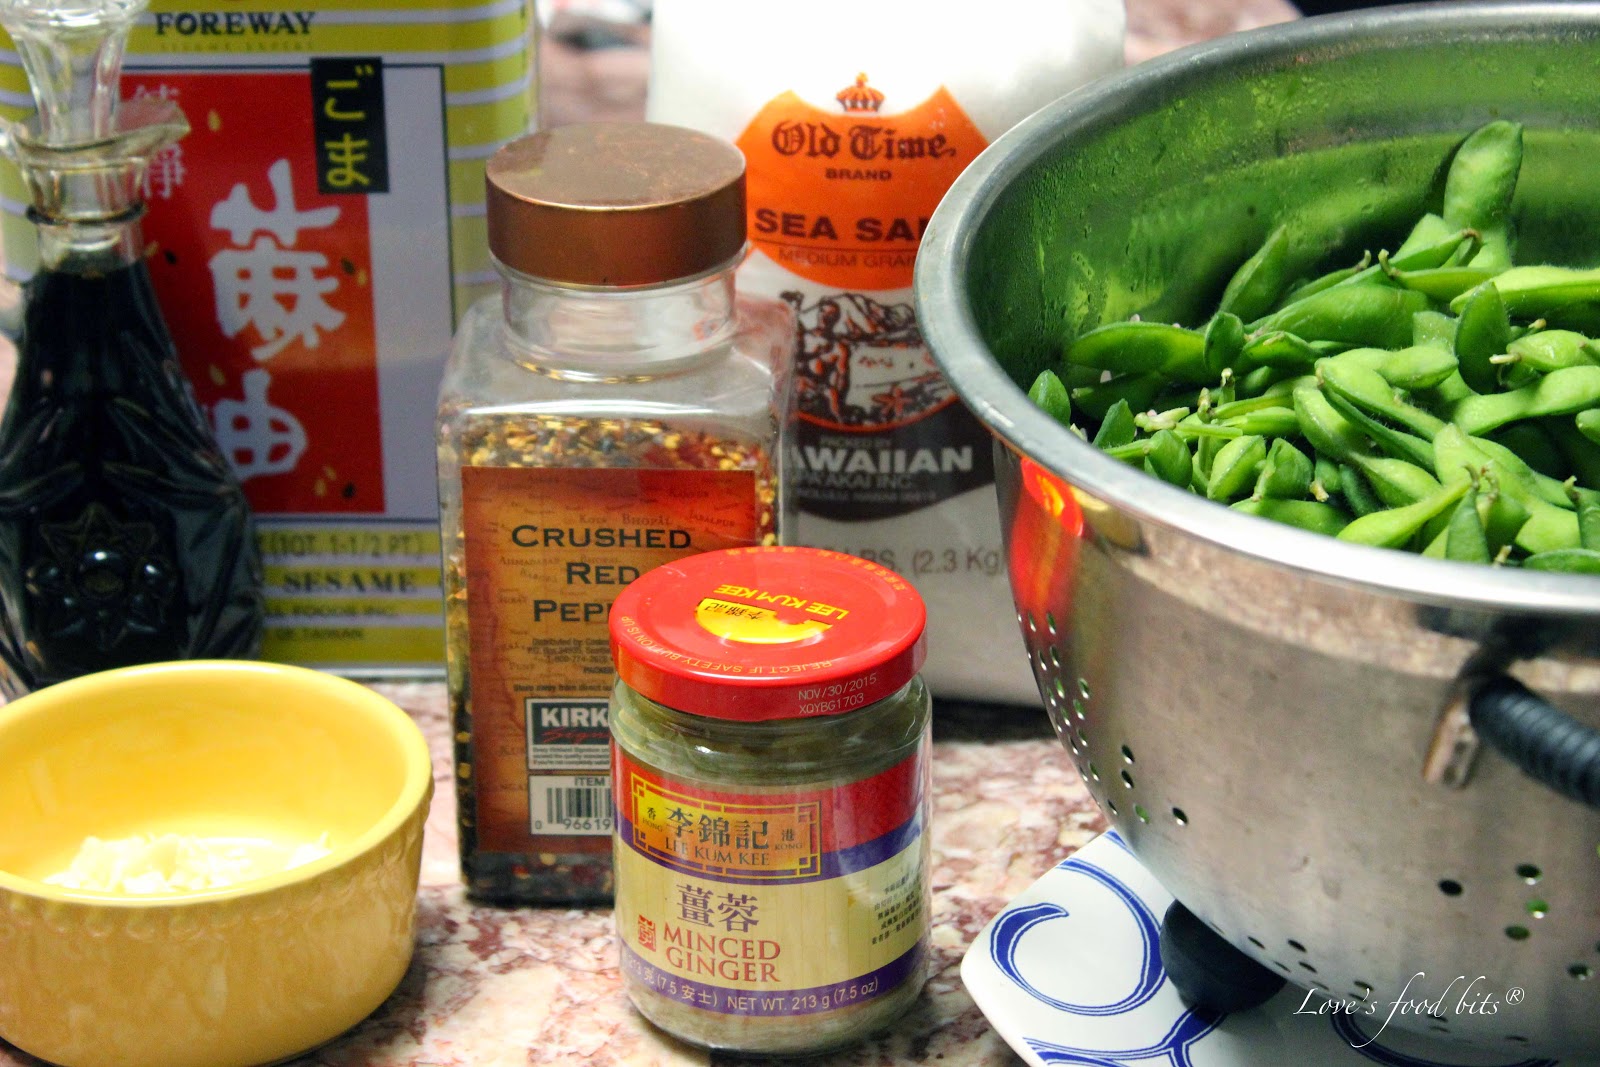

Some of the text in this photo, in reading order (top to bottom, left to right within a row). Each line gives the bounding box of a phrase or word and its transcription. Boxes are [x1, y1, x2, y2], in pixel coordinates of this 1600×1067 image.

[155, 12, 315, 35] FOREWAY
[323, 64, 372, 188] ごま
[771, 120, 840, 158] Old
[825, 168, 892, 181] BRAND
[755, 208, 838, 240] SEA
[778, 247, 917, 268] MEDIUM GRAI
[511, 524, 691, 549] CRUSHED
[566, 562, 639, 585] RED
[912, 550, 956, 576] (2.3
[284, 571, 418, 592] SESAME
[713, 584, 850, 620] LEE KUM KEE
[621, 616, 833, 674] REJECT IF SAFETY BUTTON IS UP
[798, 672, 877, 701] NOV/30/2015
[541, 707, 609, 727] KIRK
[799, 693, 864, 715] XQYBG1703
[574, 777, 605, 786] ITEM
[535, 819, 612, 830] 0 96619
[666, 807, 769, 850] 李錦記
[782, 829, 795, 841] 港
[666, 837, 770, 866] LEE KUM KEE
[775, 843, 803, 851] KONG
[676, 884, 760, 933] 薑蓉
[663, 922, 781, 961] MINCED
[666, 945, 782, 983] GINGER
[727, 996, 757, 1010] NET
[761, 997, 787, 1011] WT.
[792, 995, 817, 1010] 213
[821, 996, 830, 1009] g
[834, 985, 857, 1004] (7.5
[861, 976, 878, 995] oz)
